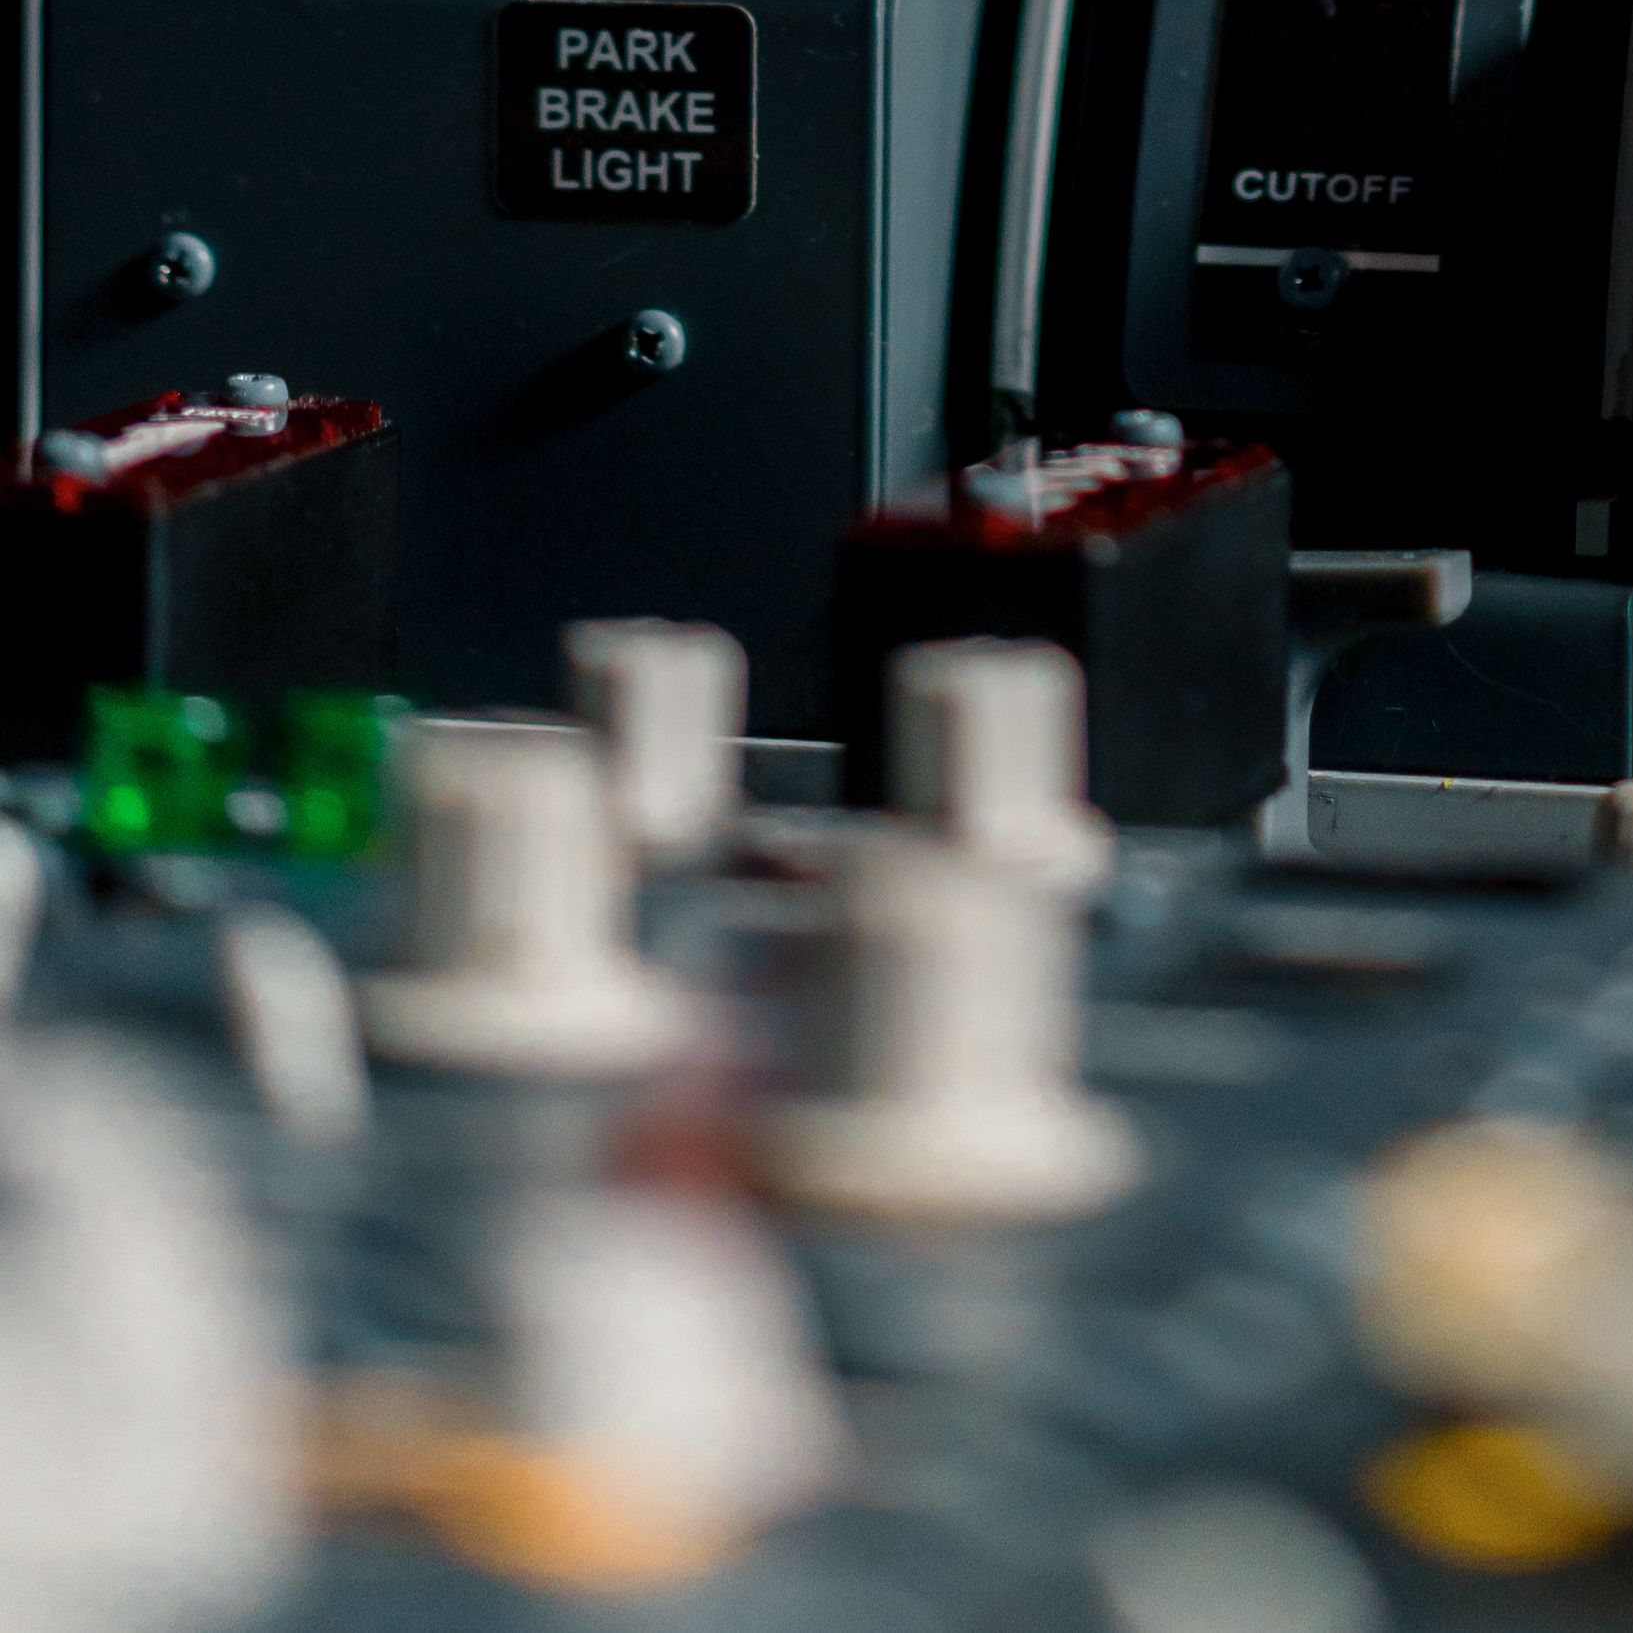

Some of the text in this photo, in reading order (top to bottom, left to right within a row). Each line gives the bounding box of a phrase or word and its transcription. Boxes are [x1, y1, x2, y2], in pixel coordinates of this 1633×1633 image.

[558, 28, 697, 73] PARK
[537, 87, 717, 134] BRAKE
[552, 148, 702, 193] LIGHT
[1232, 166, 1416, 206] CUTOFF
